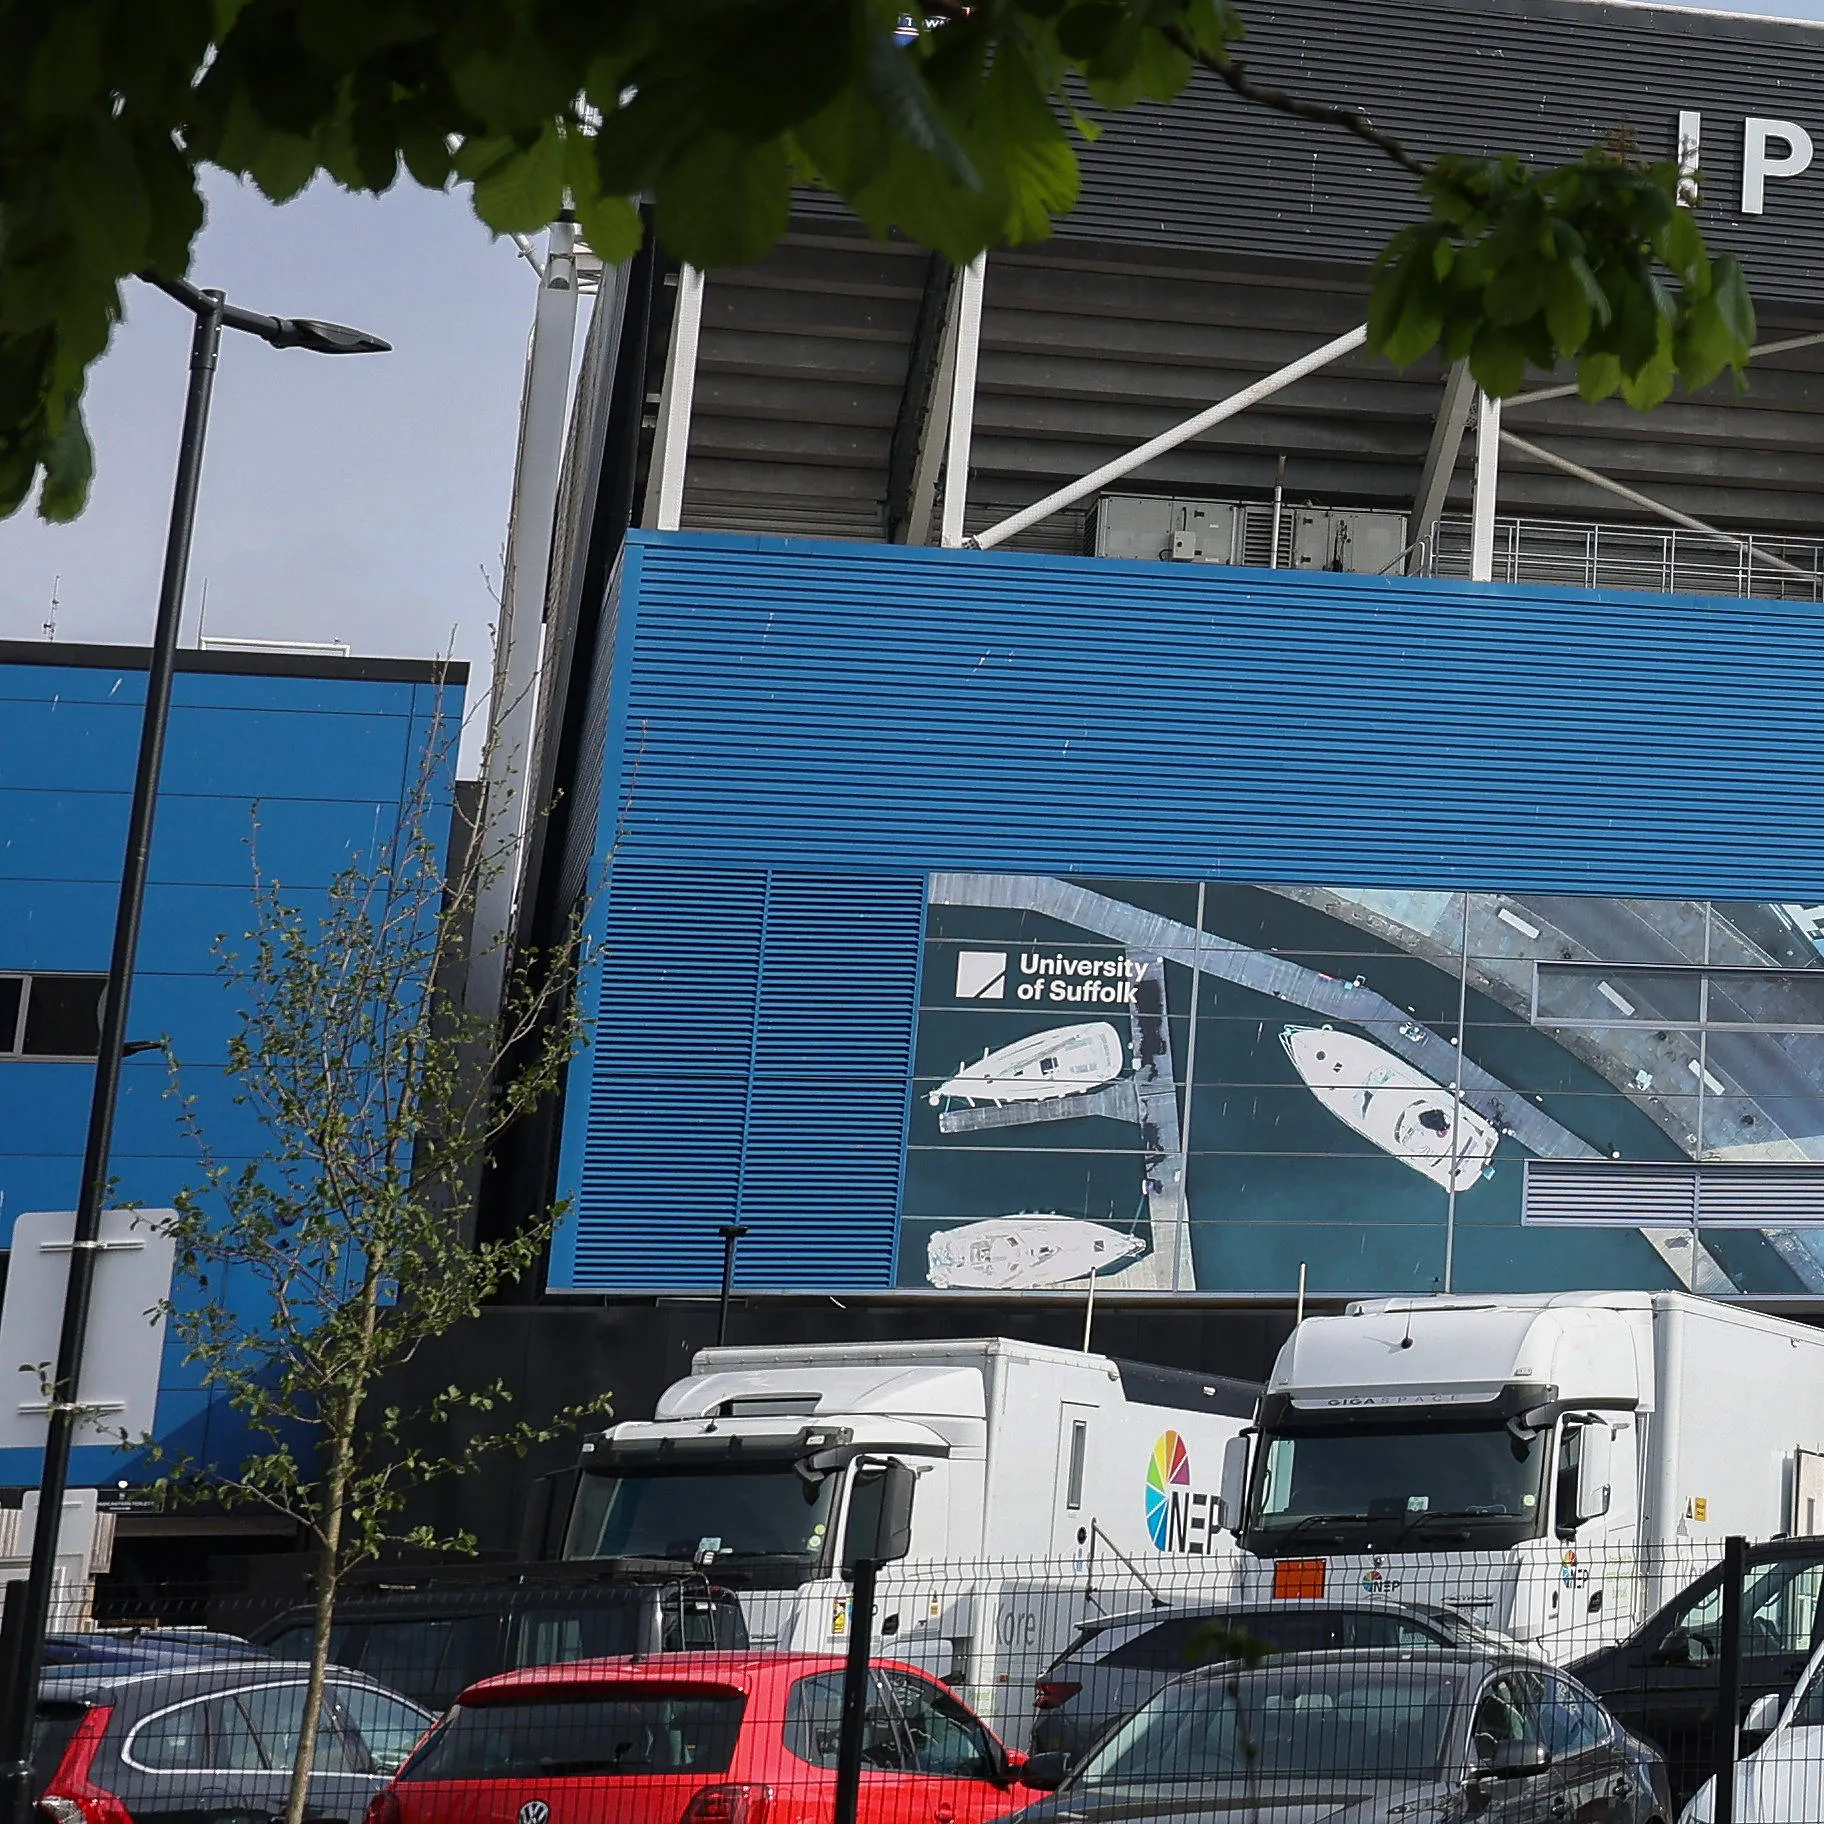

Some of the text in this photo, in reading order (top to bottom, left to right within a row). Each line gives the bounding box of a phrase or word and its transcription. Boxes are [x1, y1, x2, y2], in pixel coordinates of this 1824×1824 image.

[1020, 953, 1149, 982] University
[1017, 978, 1138, 1004] of Suffolk
[1168, 1491, 1224, 1556] NEP
[1372, 1579, 1401, 1593] NEP
